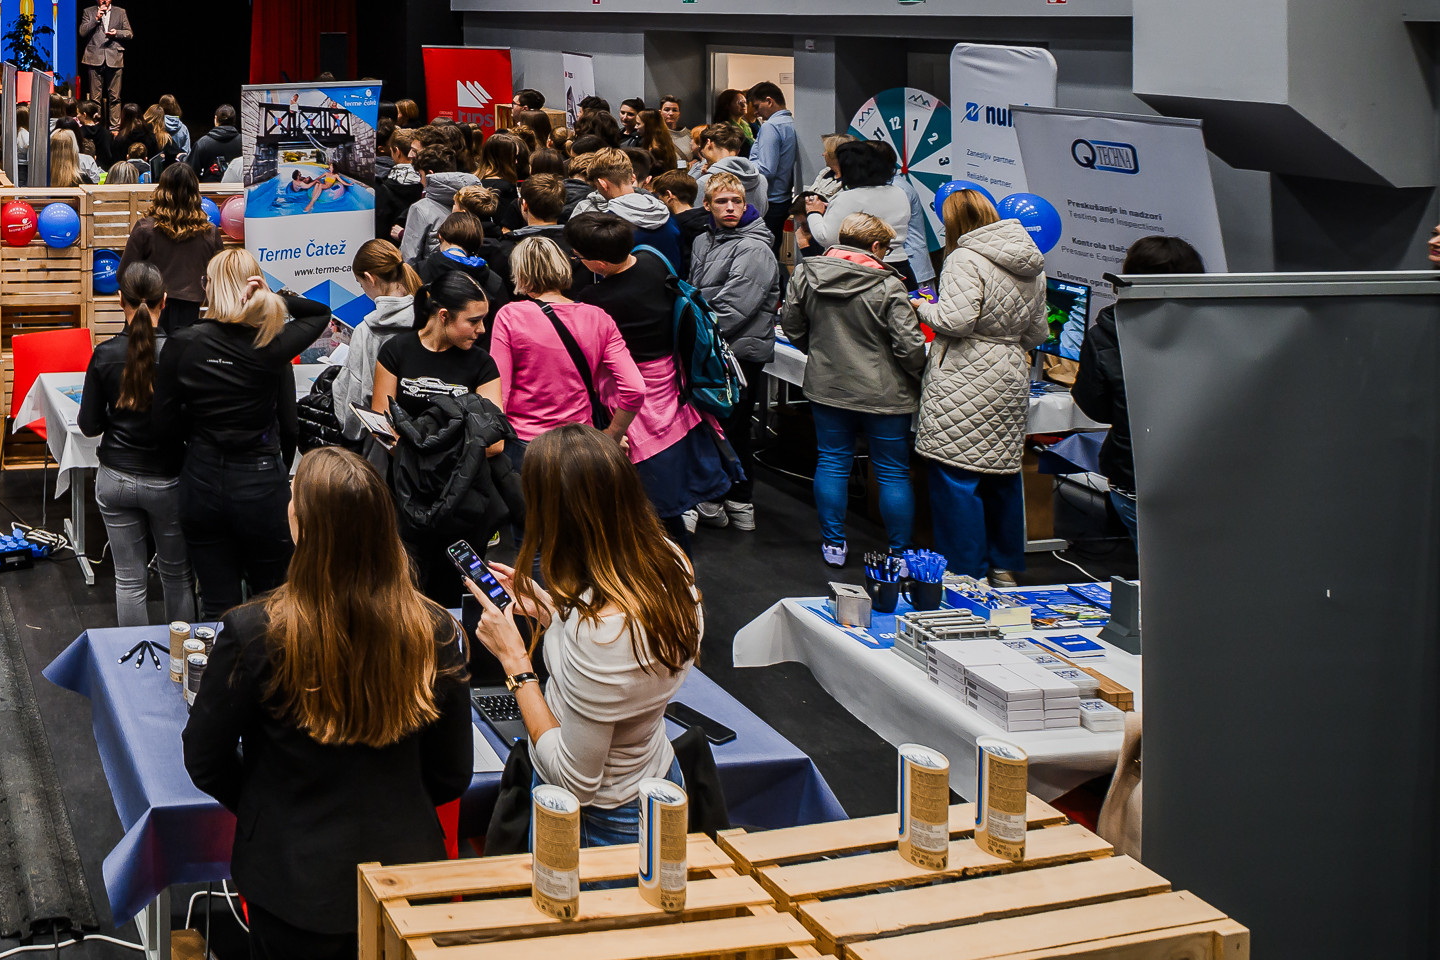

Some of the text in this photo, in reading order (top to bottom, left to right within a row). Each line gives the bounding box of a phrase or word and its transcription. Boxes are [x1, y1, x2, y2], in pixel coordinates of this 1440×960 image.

[888, 116, 902, 131] 12
[912, 119, 919, 131] 1
[927, 132, 939, 145] 2
[938, 157, 950, 166] 3
[1096, 146, 1133, 169] TECHNA
[967, 171, 989, 183] Reliable
[1067, 199, 1162, 221] Preskušanje in nadzori
[1068, 210, 1098, 223] Testing
[1099, 214, 1115, 224] and
[258, 239, 347, 262] Terme Čatež
[1071, 236, 1106, 251] Kontrola
[1061, 245, 1095, 259] Pressure
[294, 265, 352, 277] www.terme-ca
[1057, 270, 1089, 284] Delovna
